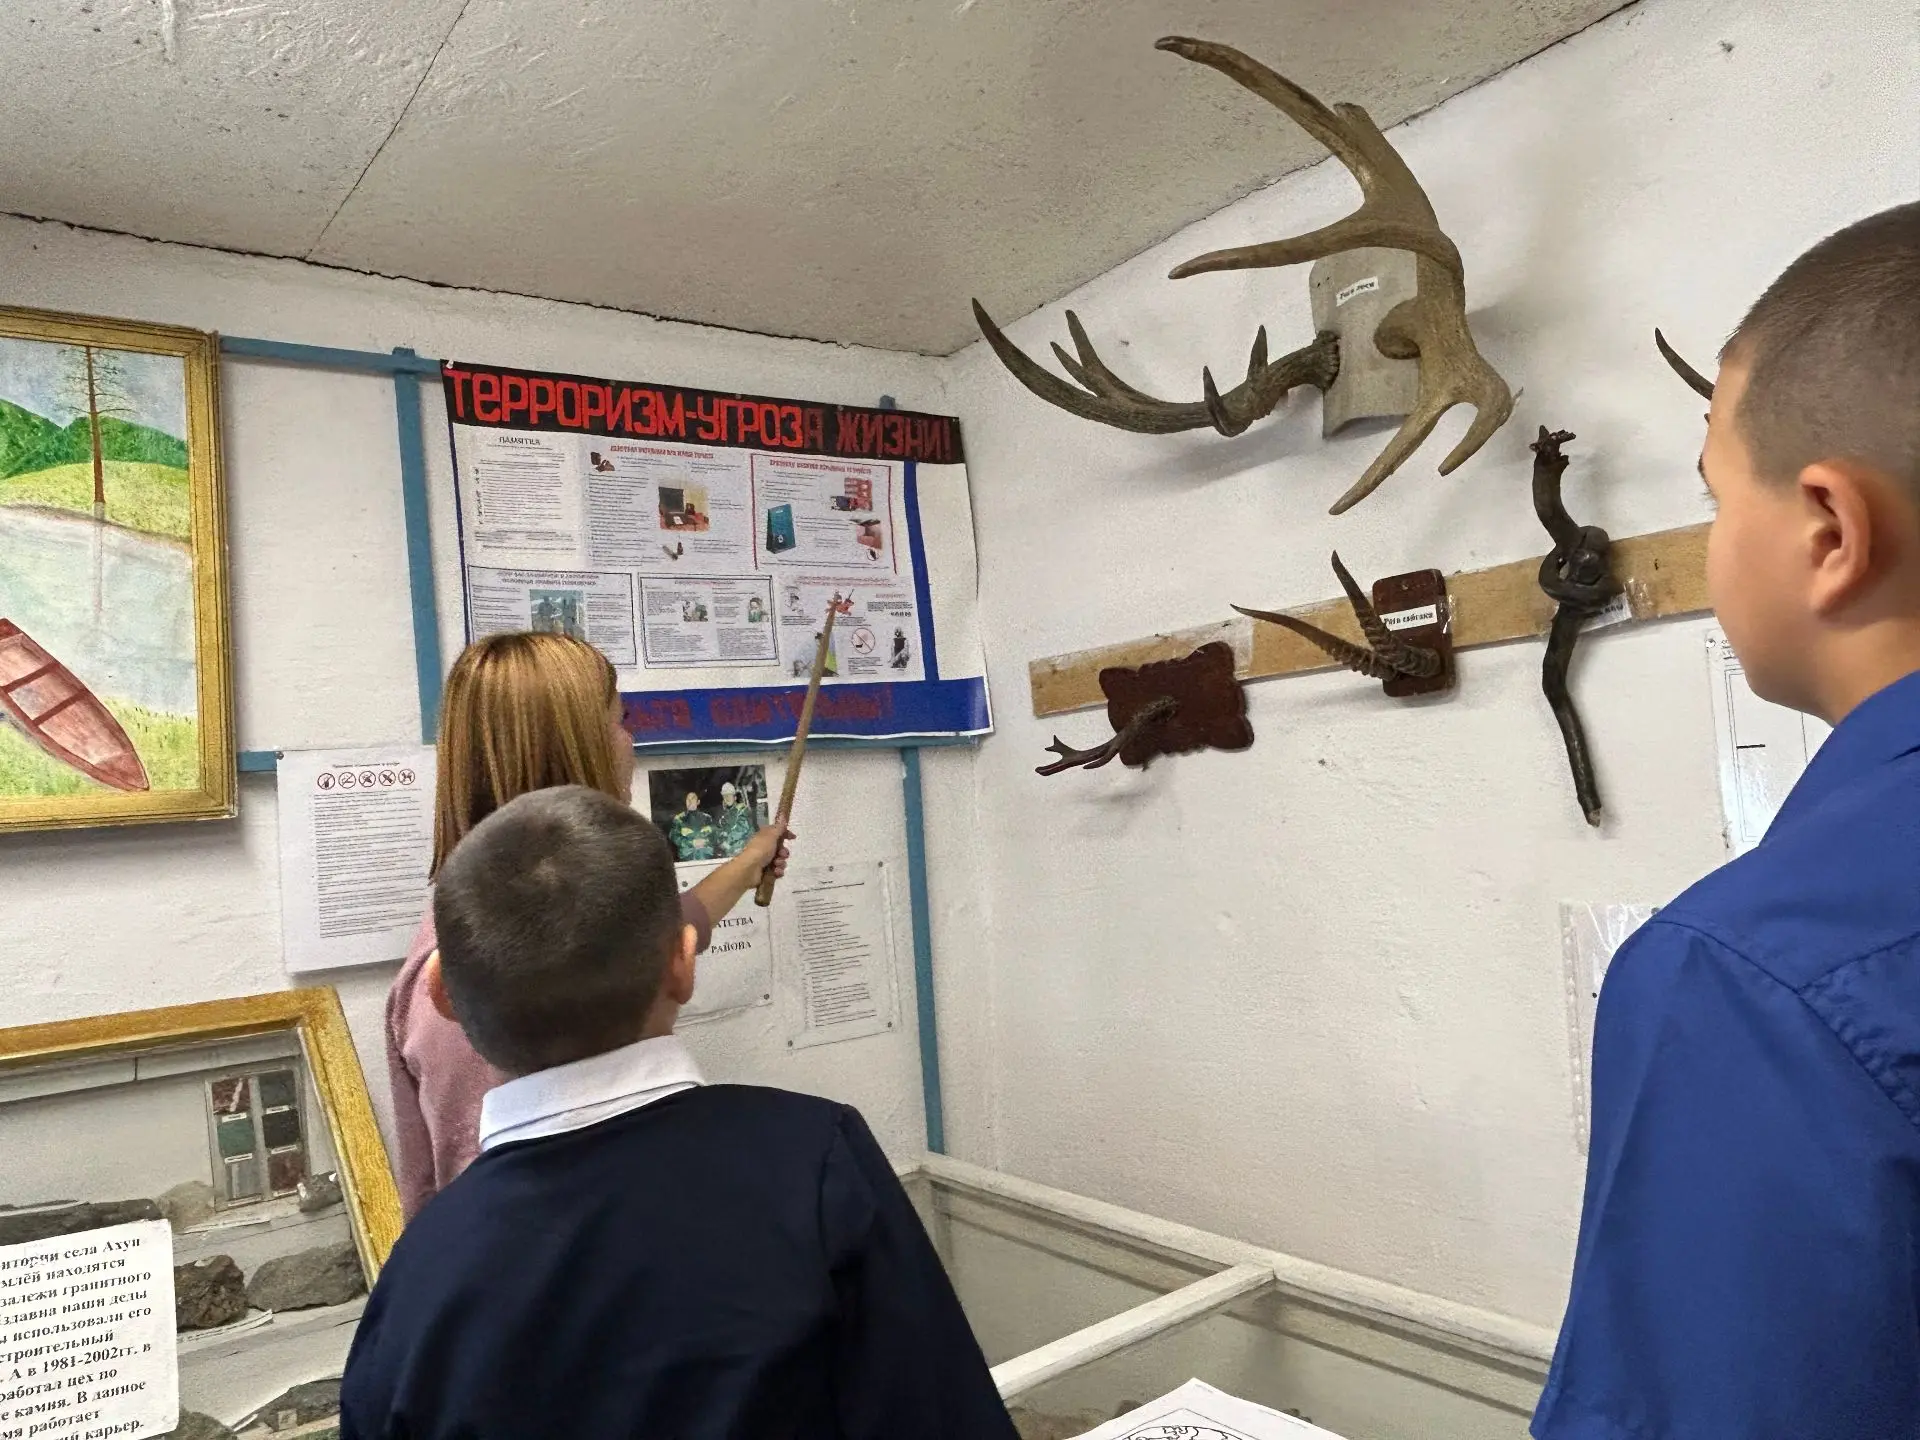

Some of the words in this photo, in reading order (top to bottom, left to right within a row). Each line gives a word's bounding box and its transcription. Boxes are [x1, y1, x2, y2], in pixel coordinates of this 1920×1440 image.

[711, 941, 752, 954] РАЙОНА
[64, 1246, 97, 1259] села
[46, 1259, 125, 1280] находятся
[0, 1289, 58, 1308] залежи
[62, 1271, 151, 1297] гранитного
[0, 1307, 57, 1326] здавна
[62, 1298, 105, 1314] наши
[13, 1312, 123, 1341] использовали
[128, 1307, 151, 1319] его
[9, 1368, 21, 1381] А
[27, 1367, 37, 1377] в
[143, 1343, 151, 1353] в
[68, 1373, 94, 1388] цех
[99, 1369, 118, 1381] по
[15, 1399, 71, 1418] камня.
[77, 1390, 88, 1404] В
[92, 1381, 146, 1402] данное
[29, 1408, 101, 1438] работает
[86, 1420, 145, 1439] карьер.
